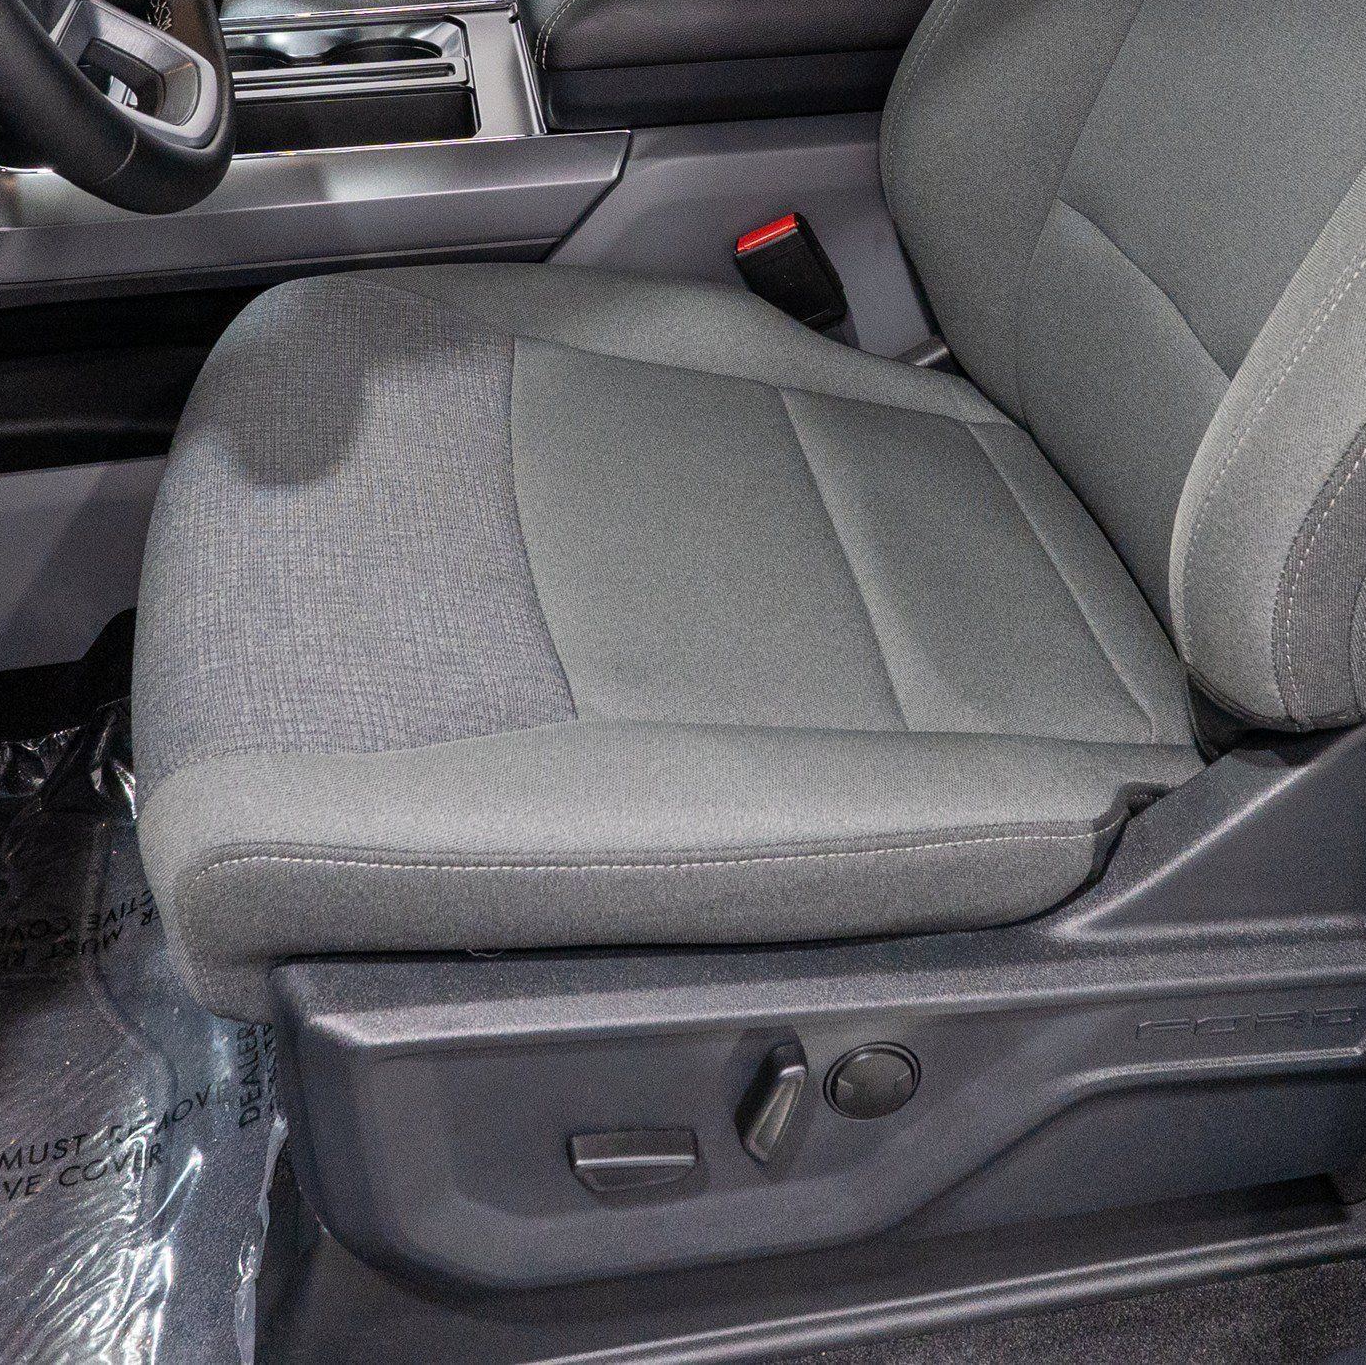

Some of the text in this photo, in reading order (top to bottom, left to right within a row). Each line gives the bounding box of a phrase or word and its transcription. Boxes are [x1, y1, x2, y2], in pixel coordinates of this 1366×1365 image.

[43, 924, 123, 962] MUST
[1136, 1004, 1362, 1040] FORD
[238, 1025, 263, 1129] DEALER
[58, 1142, 166, 1189] COVER
